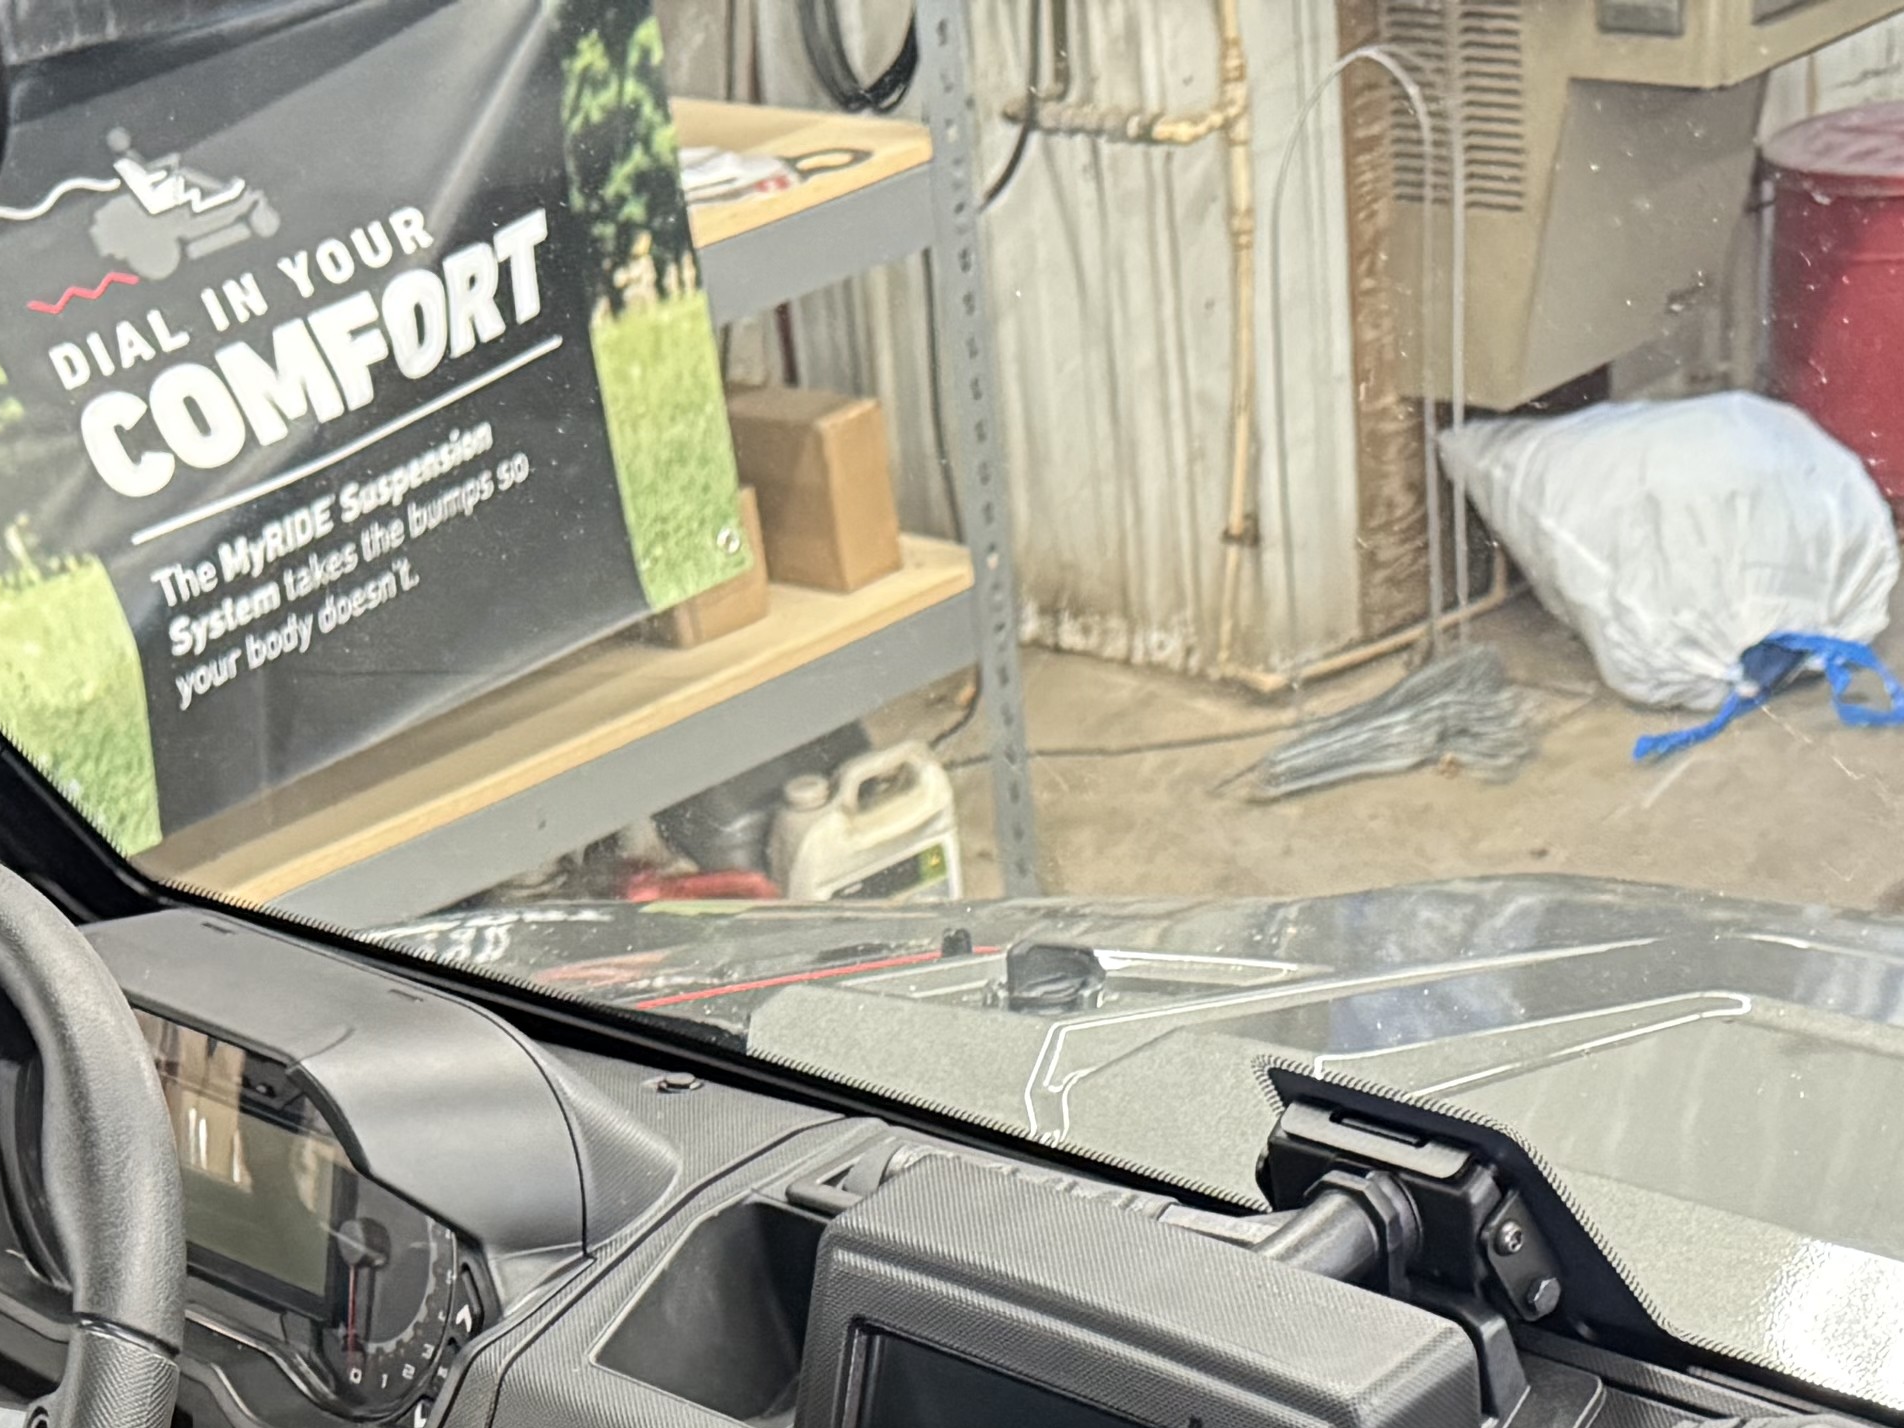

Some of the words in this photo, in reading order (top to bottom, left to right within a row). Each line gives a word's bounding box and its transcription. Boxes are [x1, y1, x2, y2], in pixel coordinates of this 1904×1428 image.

[49, 309, 190, 391] DIAL
[201, 271, 269, 332] IN
[277, 205, 434, 298] YOUR
[80, 207, 549, 498] COMFORT
[150, 562, 218, 608] The
[338, 421, 494, 524] Suspension
[169, 580, 281, 657] System
[283, 541, 358, 602] takes
[360, 517, 406, 563] the
[407, 470, 495, 539] bumps
[496, 451, 530, 491] so
[175, 648, 242, 711] your
[245, 610, 314, 671] body
[318, 556, 420, 634] doesn't.
[380, 1373, 388, 1388] 1
[401, 1362, 416, 1380] 2
[421, 1343, 434, 1360] 3
